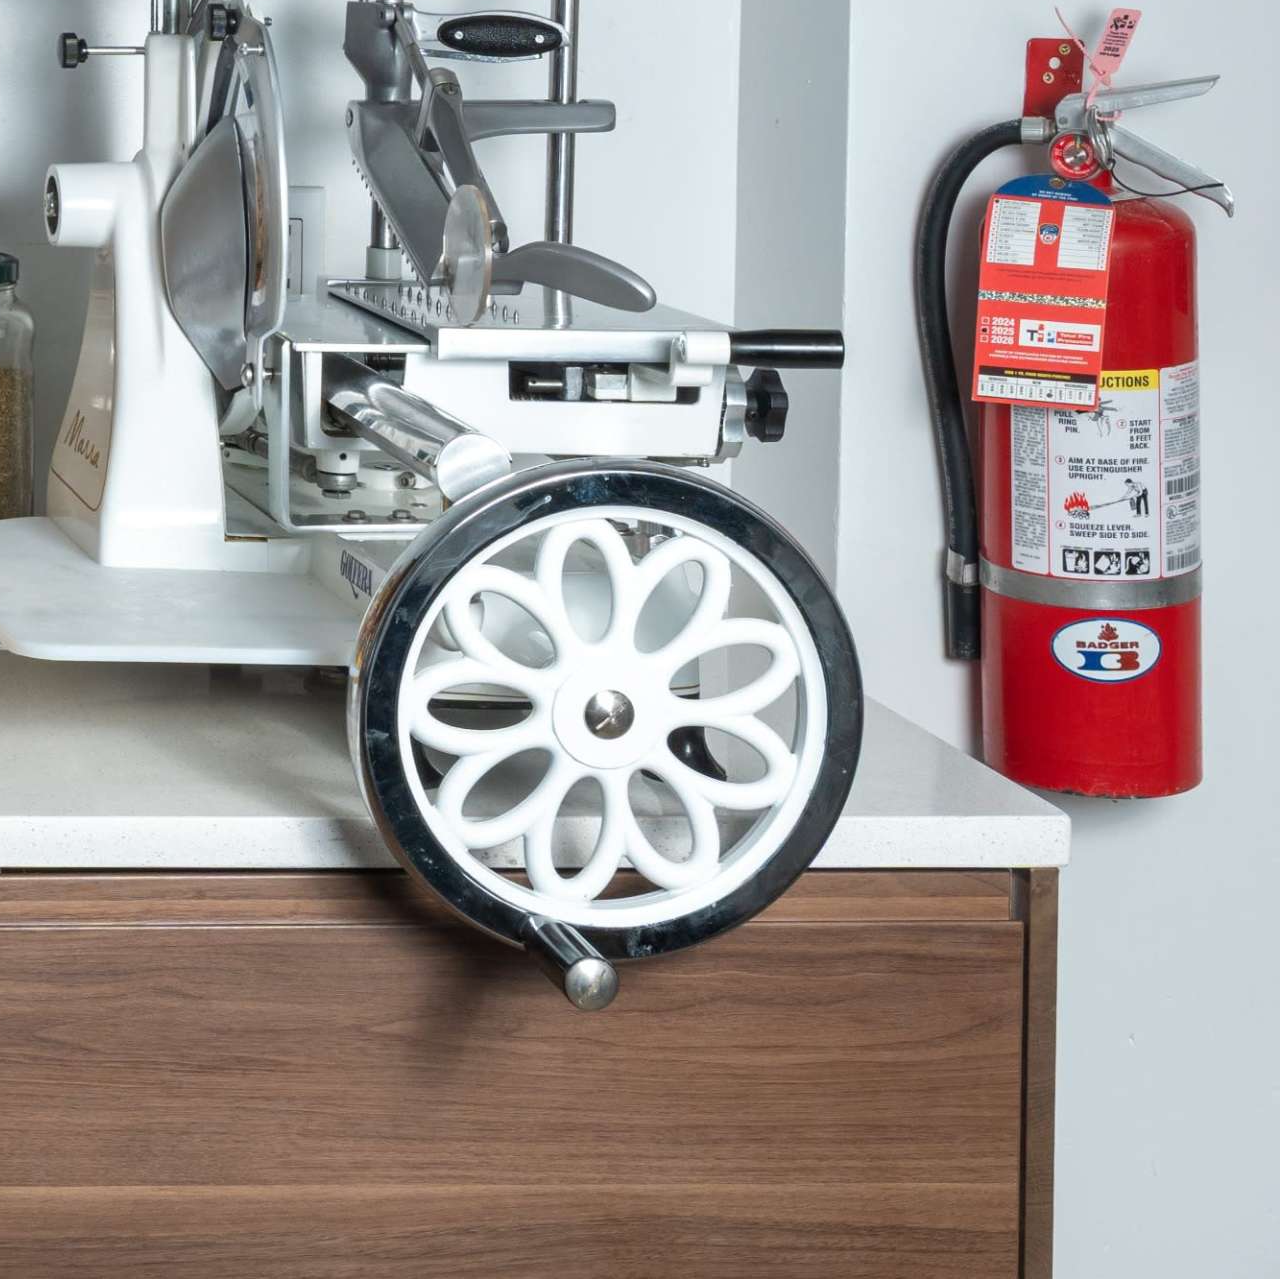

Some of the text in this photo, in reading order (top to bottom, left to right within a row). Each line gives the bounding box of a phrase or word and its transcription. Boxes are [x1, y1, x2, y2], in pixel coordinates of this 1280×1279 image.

[991, 317, 1015, 326] 2024
[991, 326, 1015, 336] 2025
[991, 335, 1015, 345] 2026
[1101, 375, 1150, 388] UCTIONS
[1058, 418, 1077, 426] RING
[1068, 457, 1083, 465] AIM
[1085, 457, 1095, 465] AT
[1086, 465, 1142, 473] EXTINGUISHER
[1069, 522, 1104, 531] SQUEEZE
[1076, 640, 1139, 649] BADGER
